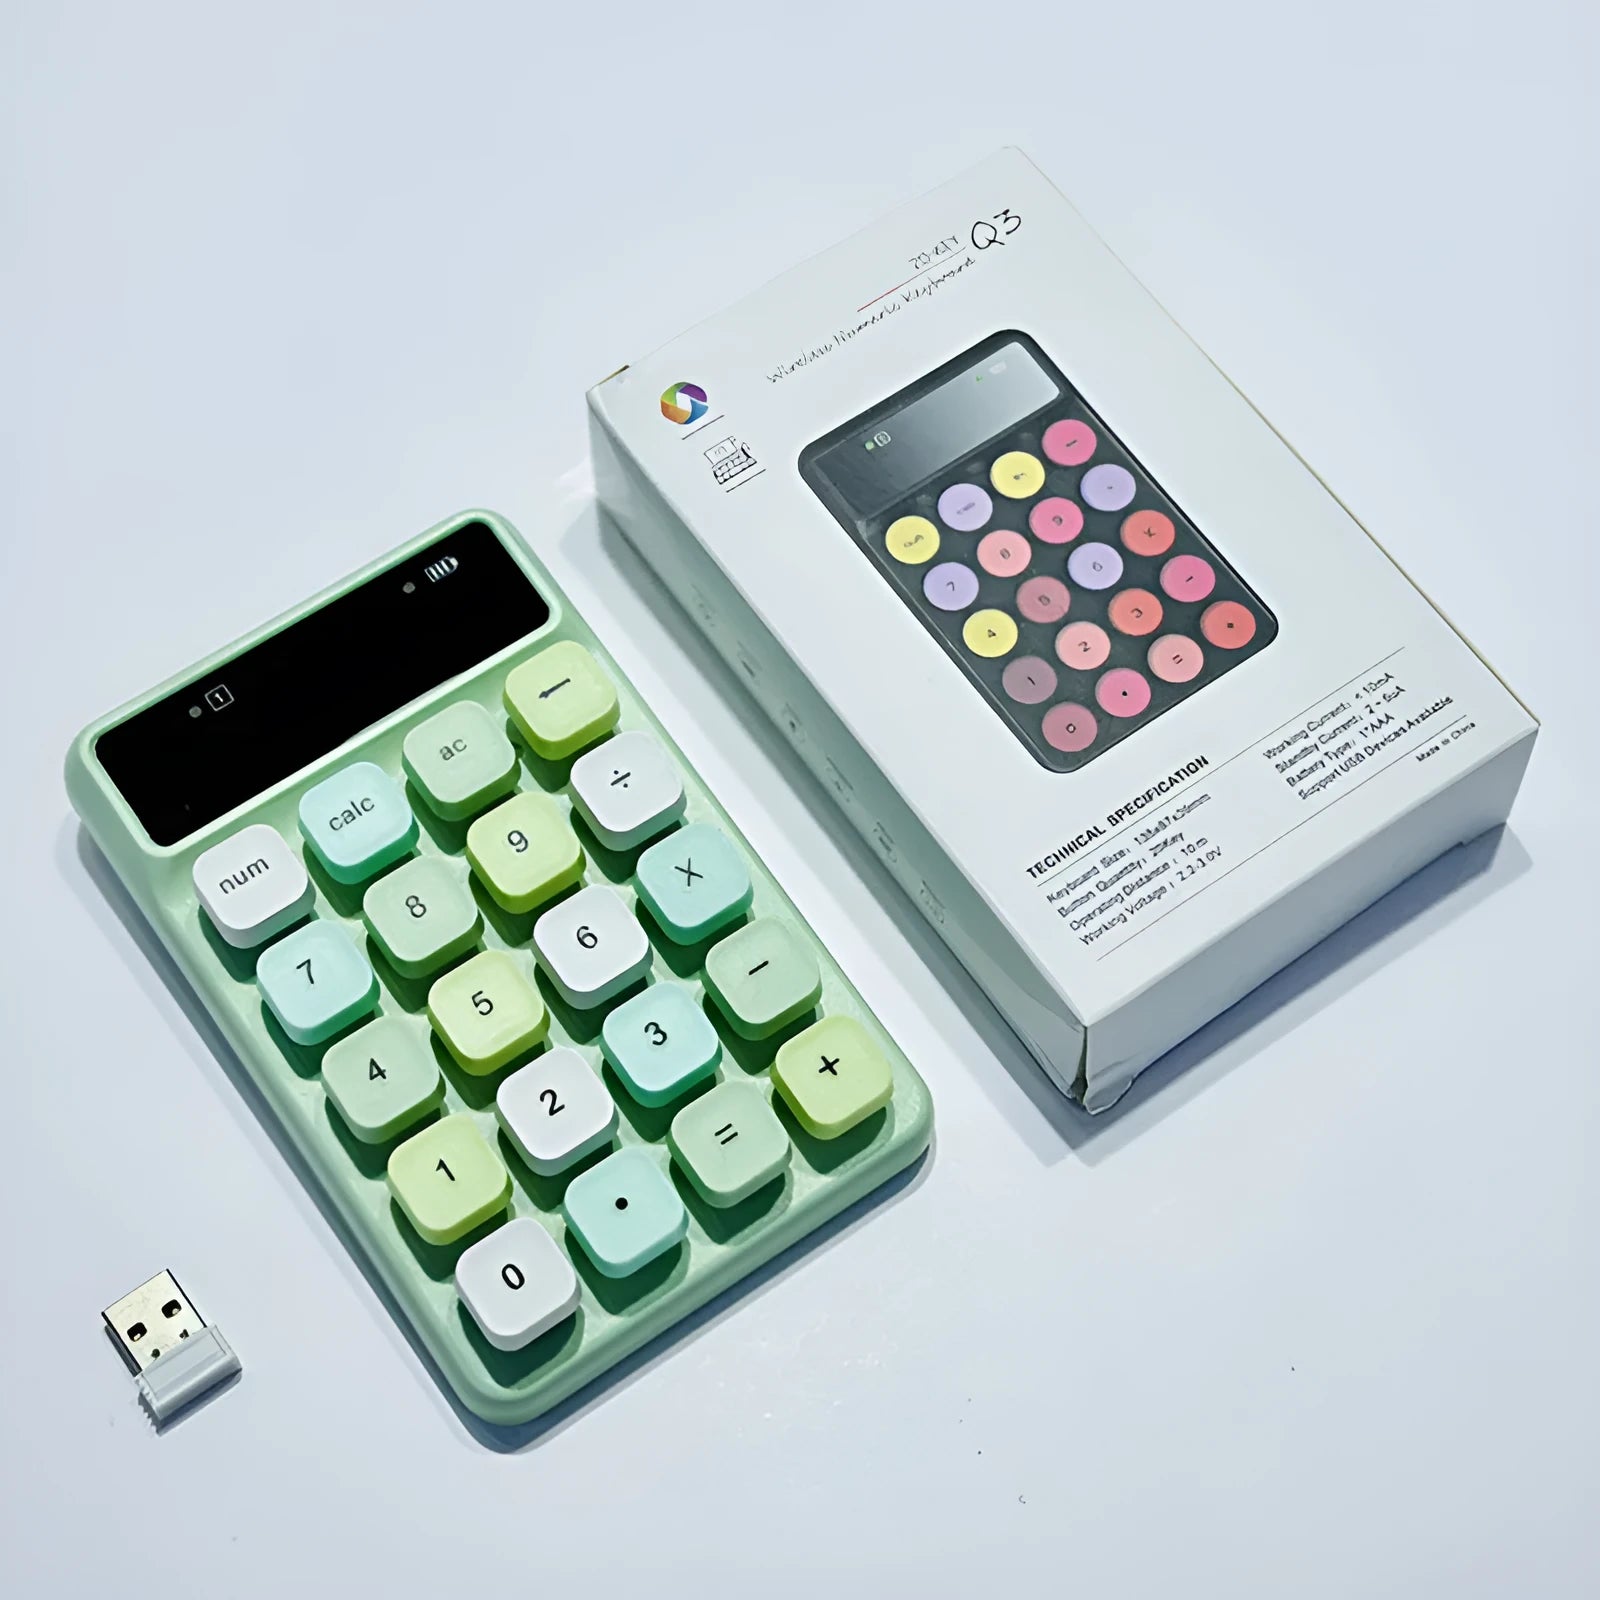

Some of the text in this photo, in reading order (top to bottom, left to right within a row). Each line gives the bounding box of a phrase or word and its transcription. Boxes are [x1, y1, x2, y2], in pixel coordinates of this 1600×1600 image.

[971, 208, 1021, 250] Q3
[439, 739, 468, 761] ac
[329, 797, 375, 831] calc
[1026, 825, 1107, 879] TECHNICAL
[1107, 755, 1209, 827] SPECIFICATION
[507, 830, 529, 854] 9
[219, 858, 270, 895] num
[405, 895, 427, 919] 8
[576, 925, 598, 949] 6
[295, 958, 317, 985] 7
[471, 990, 494, 1016] 5
[644, 1021, 668, 1046] 3
[368, 1057, 387, 1082] 4
[539, 1088, 566, 1117] 2
[435, 1158, 456, 1182] 1
[501, 1263, 526, 1291] 0
